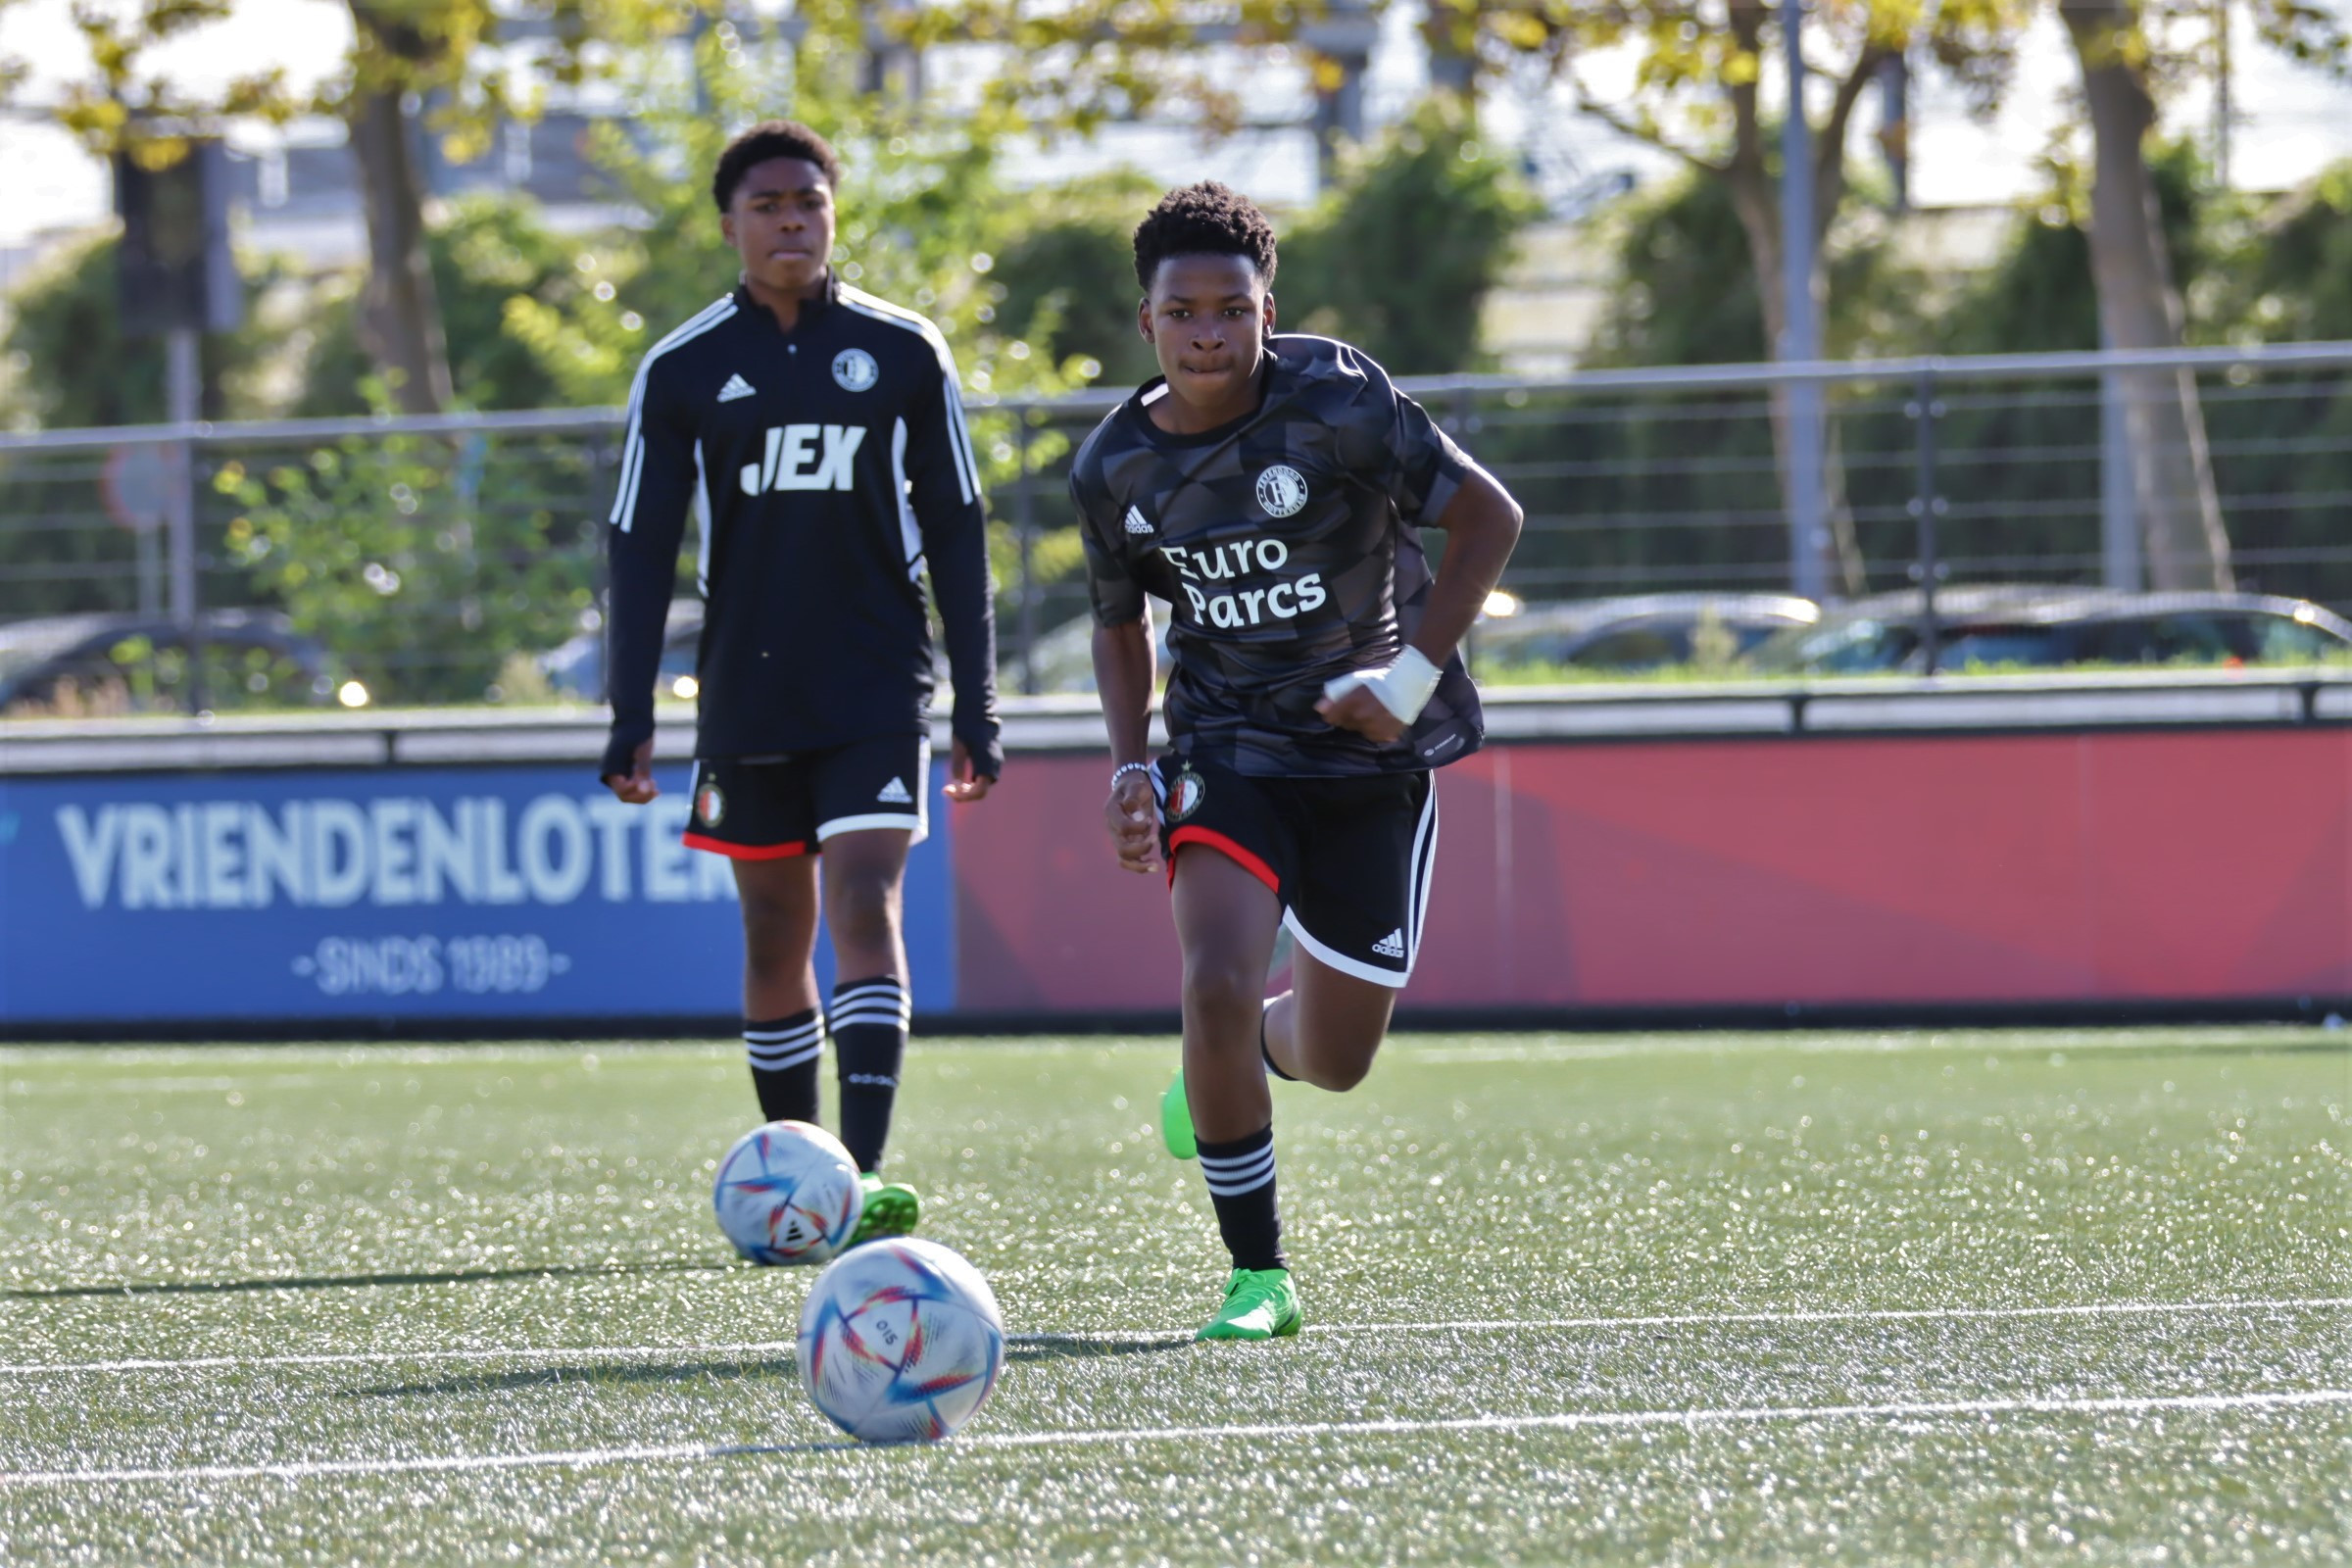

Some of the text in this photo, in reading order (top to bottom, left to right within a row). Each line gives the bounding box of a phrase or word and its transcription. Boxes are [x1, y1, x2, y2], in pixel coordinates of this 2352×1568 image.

[740, 423, 867, 497] JEX
[1159, 539, 1288, 581] Euro
[1182, 572, 1326, 628] Parcs
